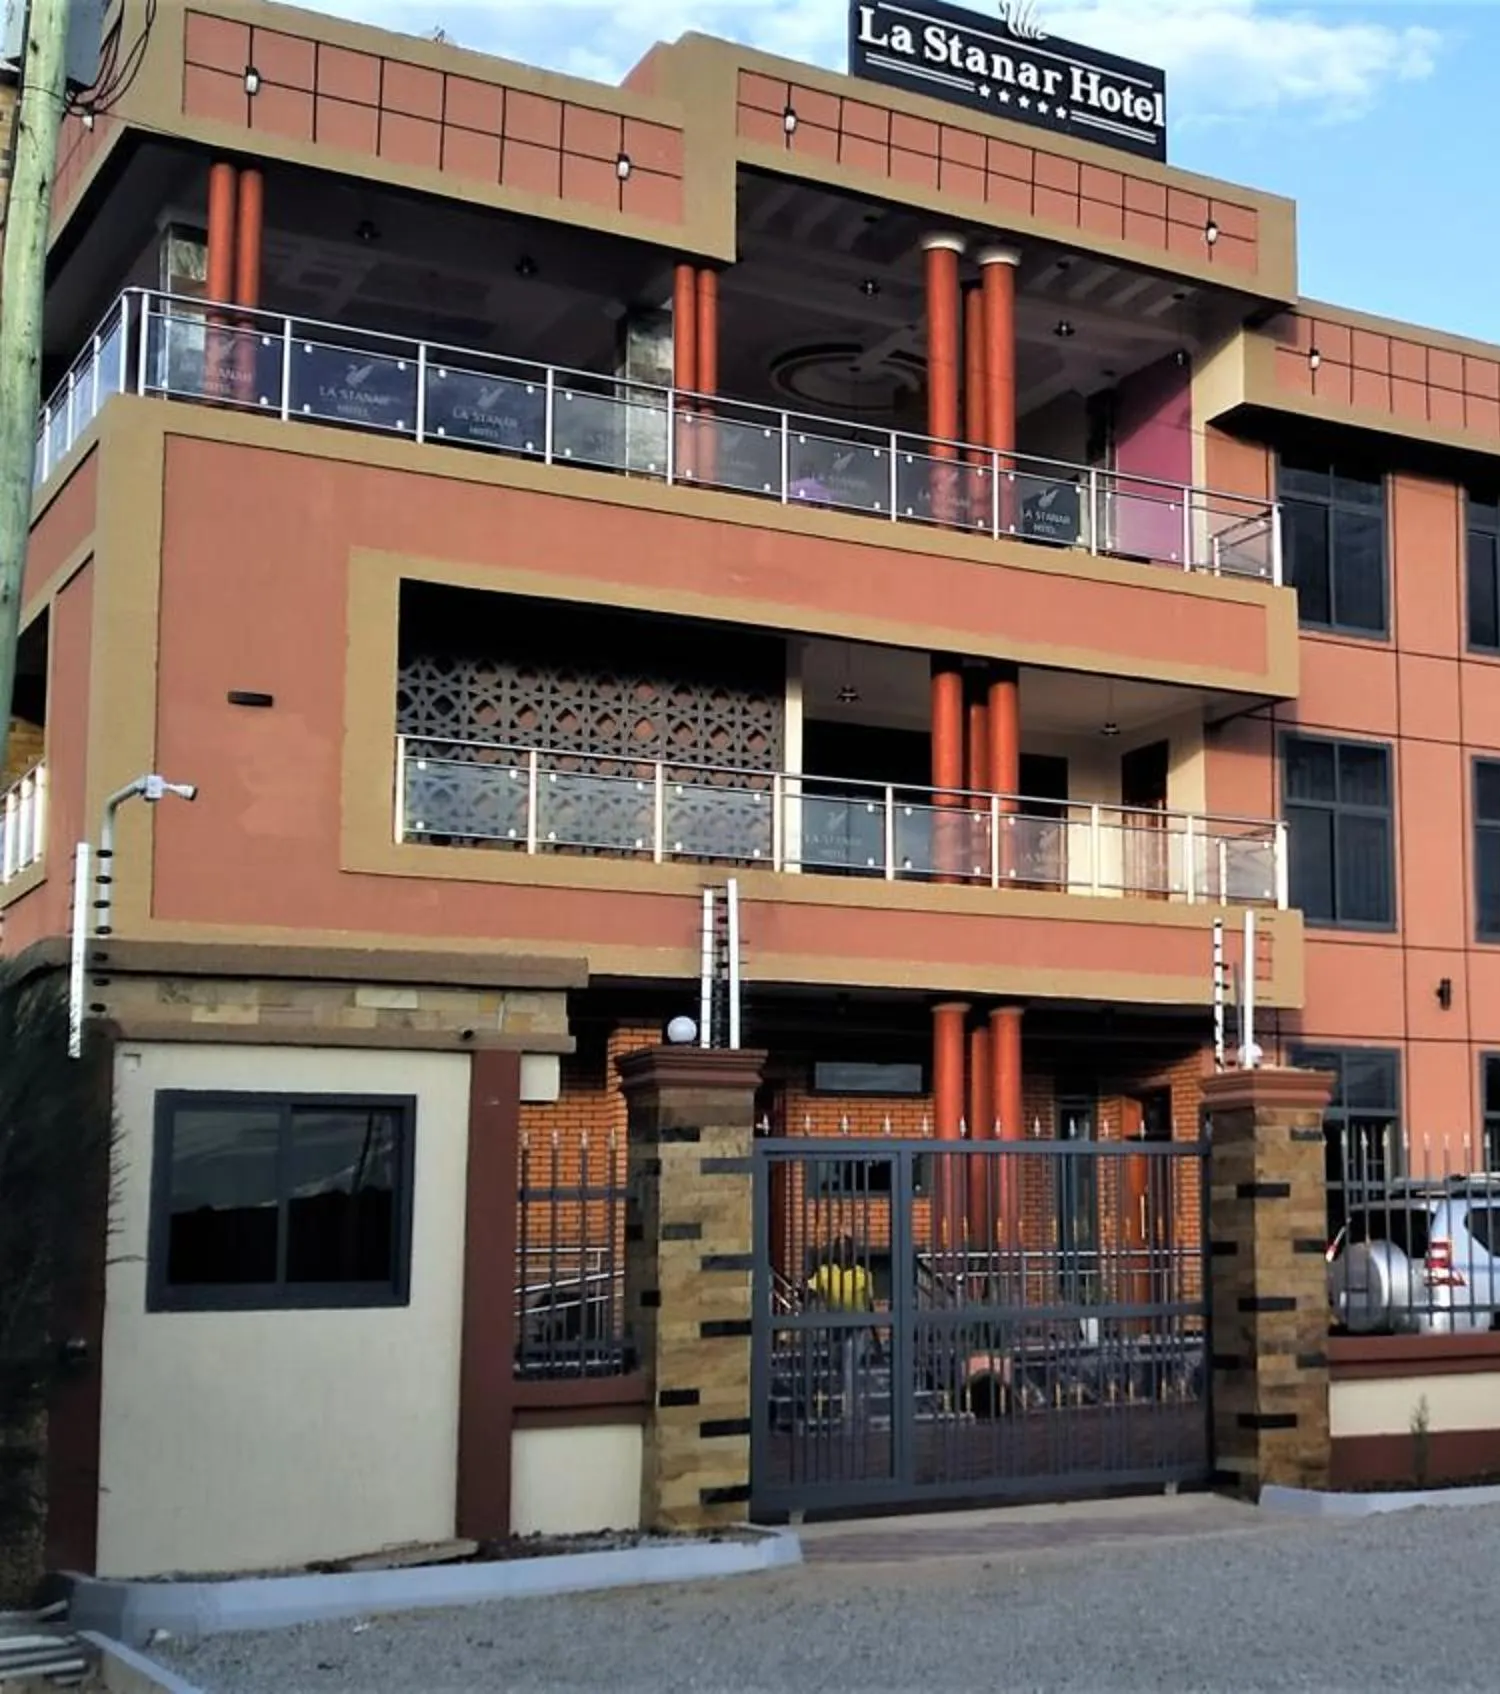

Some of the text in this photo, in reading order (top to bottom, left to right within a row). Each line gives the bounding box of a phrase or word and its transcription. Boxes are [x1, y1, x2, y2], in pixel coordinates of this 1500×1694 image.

[858, 5, 1165, 127] La Stanar Hotel
